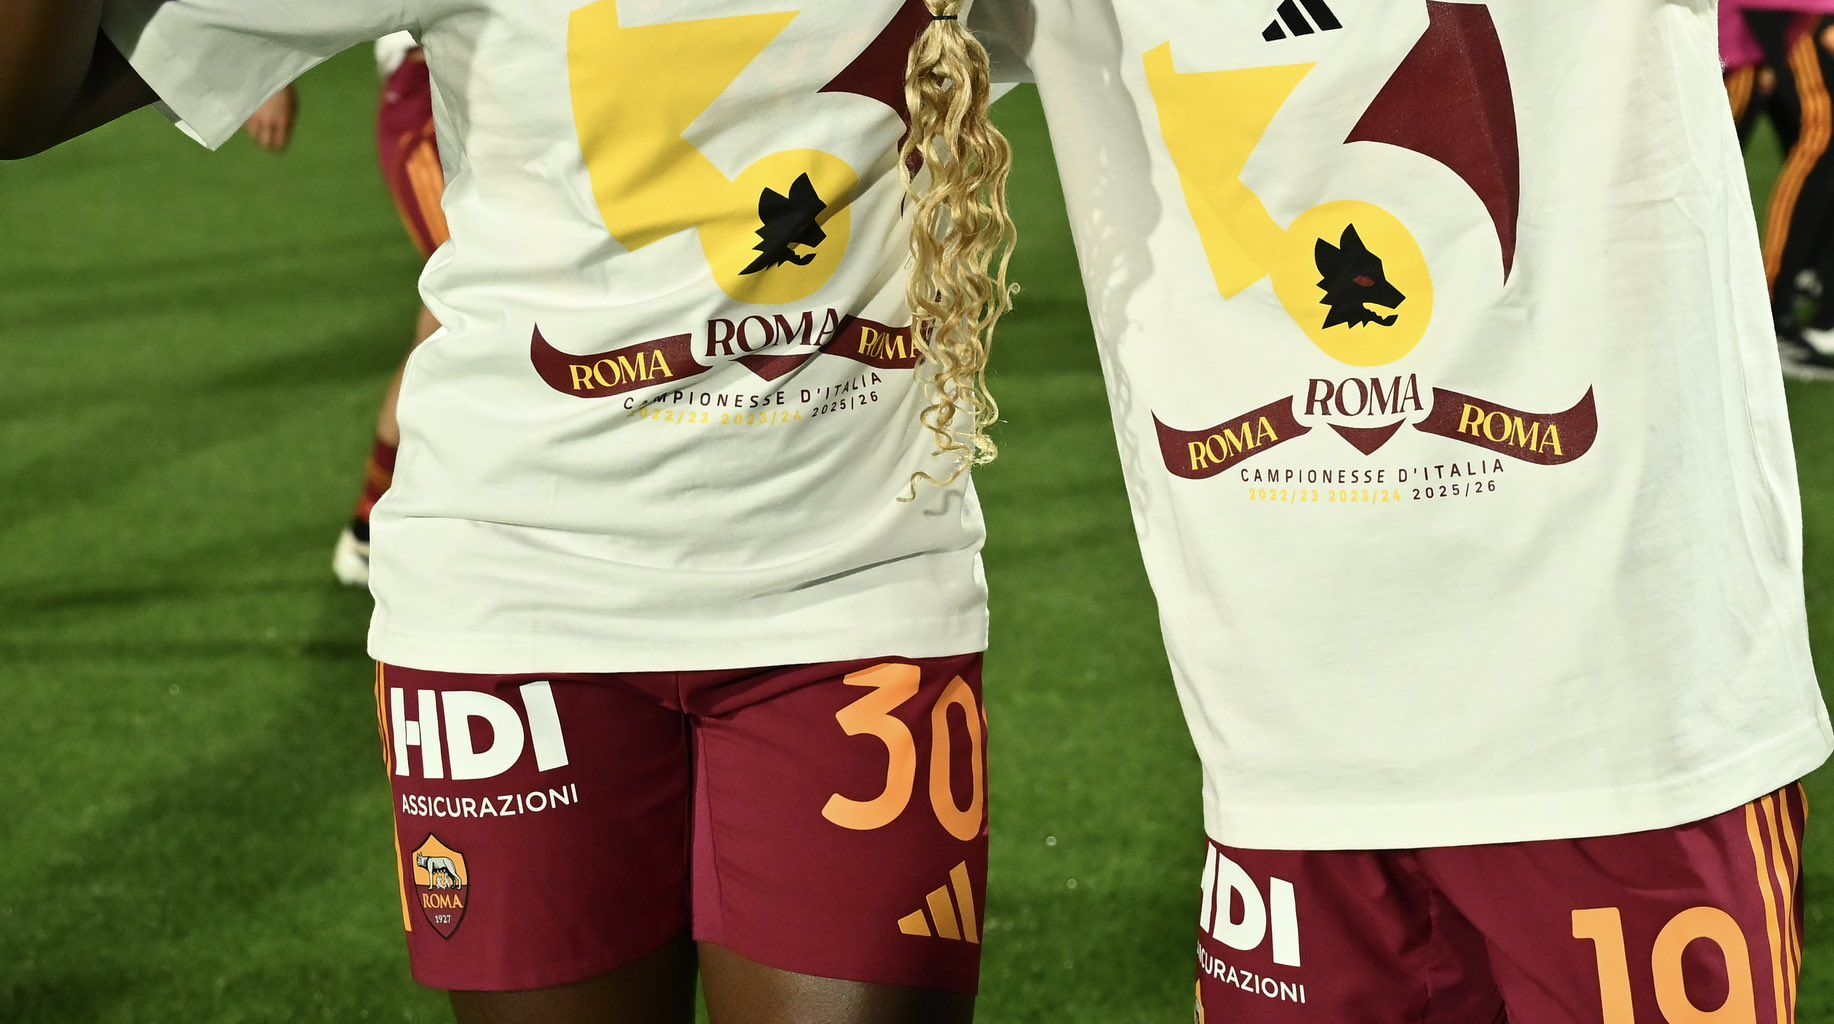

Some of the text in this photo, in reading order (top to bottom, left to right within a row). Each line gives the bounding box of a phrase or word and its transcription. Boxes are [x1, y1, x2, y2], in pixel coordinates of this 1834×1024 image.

[569, 349, 673, 390] ROMA
[705, 307, 840, 357] ROMA
[801, 372, 882, 404] D'ITALIA
[811, 391, 879, 418] 2025/26
[1187, 373, 1564, 471] ROMA ROMA ROMA
[1240, 458, 1504, 484] CAMPIONESSE D'ITALIA
[1249, 480, 1496, 505] 2022/23 2023/24 2025/26
[390, 680, 569, 781] HDI
[821, 662, 984, 842] 30
[402, 783, 579, 818] ASSICURAZIONI
[422, 893, 464, 909] ROMA
[435, 914, 451, 924] 1927
[1571, 906, 1757, 1024] 19
